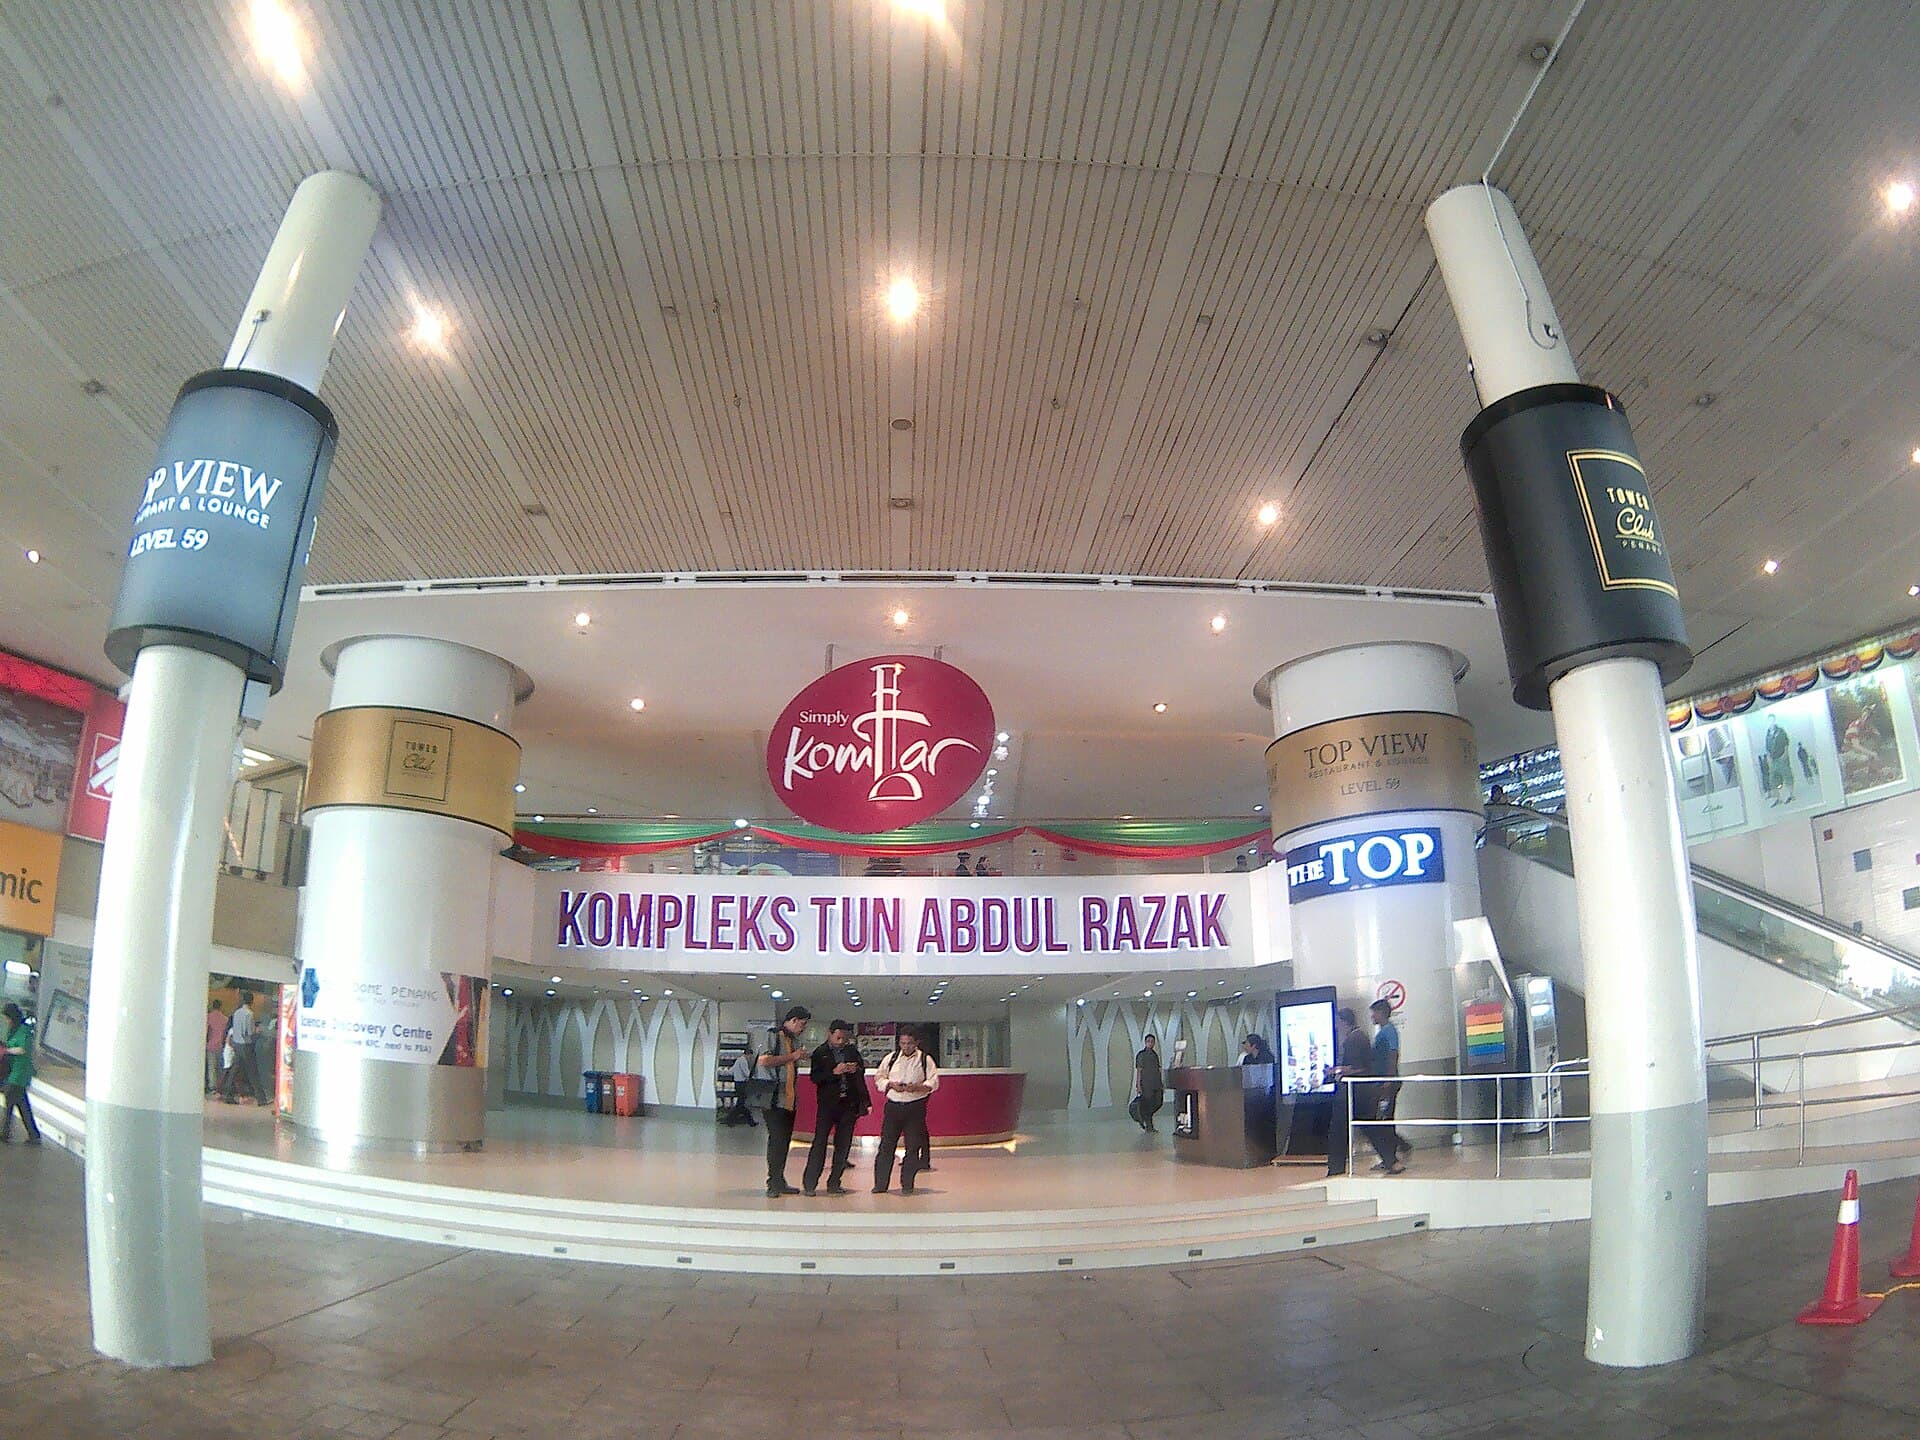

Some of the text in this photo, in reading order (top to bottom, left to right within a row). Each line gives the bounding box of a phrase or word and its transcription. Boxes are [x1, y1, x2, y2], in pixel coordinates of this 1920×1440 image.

[174, 459, 282, 510] VIEW
[1607, 487, 1649, 511] TOWER
[198, 496, 270, 529] LOUNGE
[1617, 507, 1654, 540] Club
[130, 527, 210, 558] LEVEL 59
[799, 710, 850, 727] Simply
[1304, 740, 1352, 769] TOP
[1359, 733, 1428, 757] VIEW
[1341, 779, 1381, 796] LEVEL
[1288, 832, 1434, 887] THE TOP
[557, 890, 1229, 954] KOMPLEKS TUN ABDUL RAZAK
[392, 1024, 433, 1040] Centre
